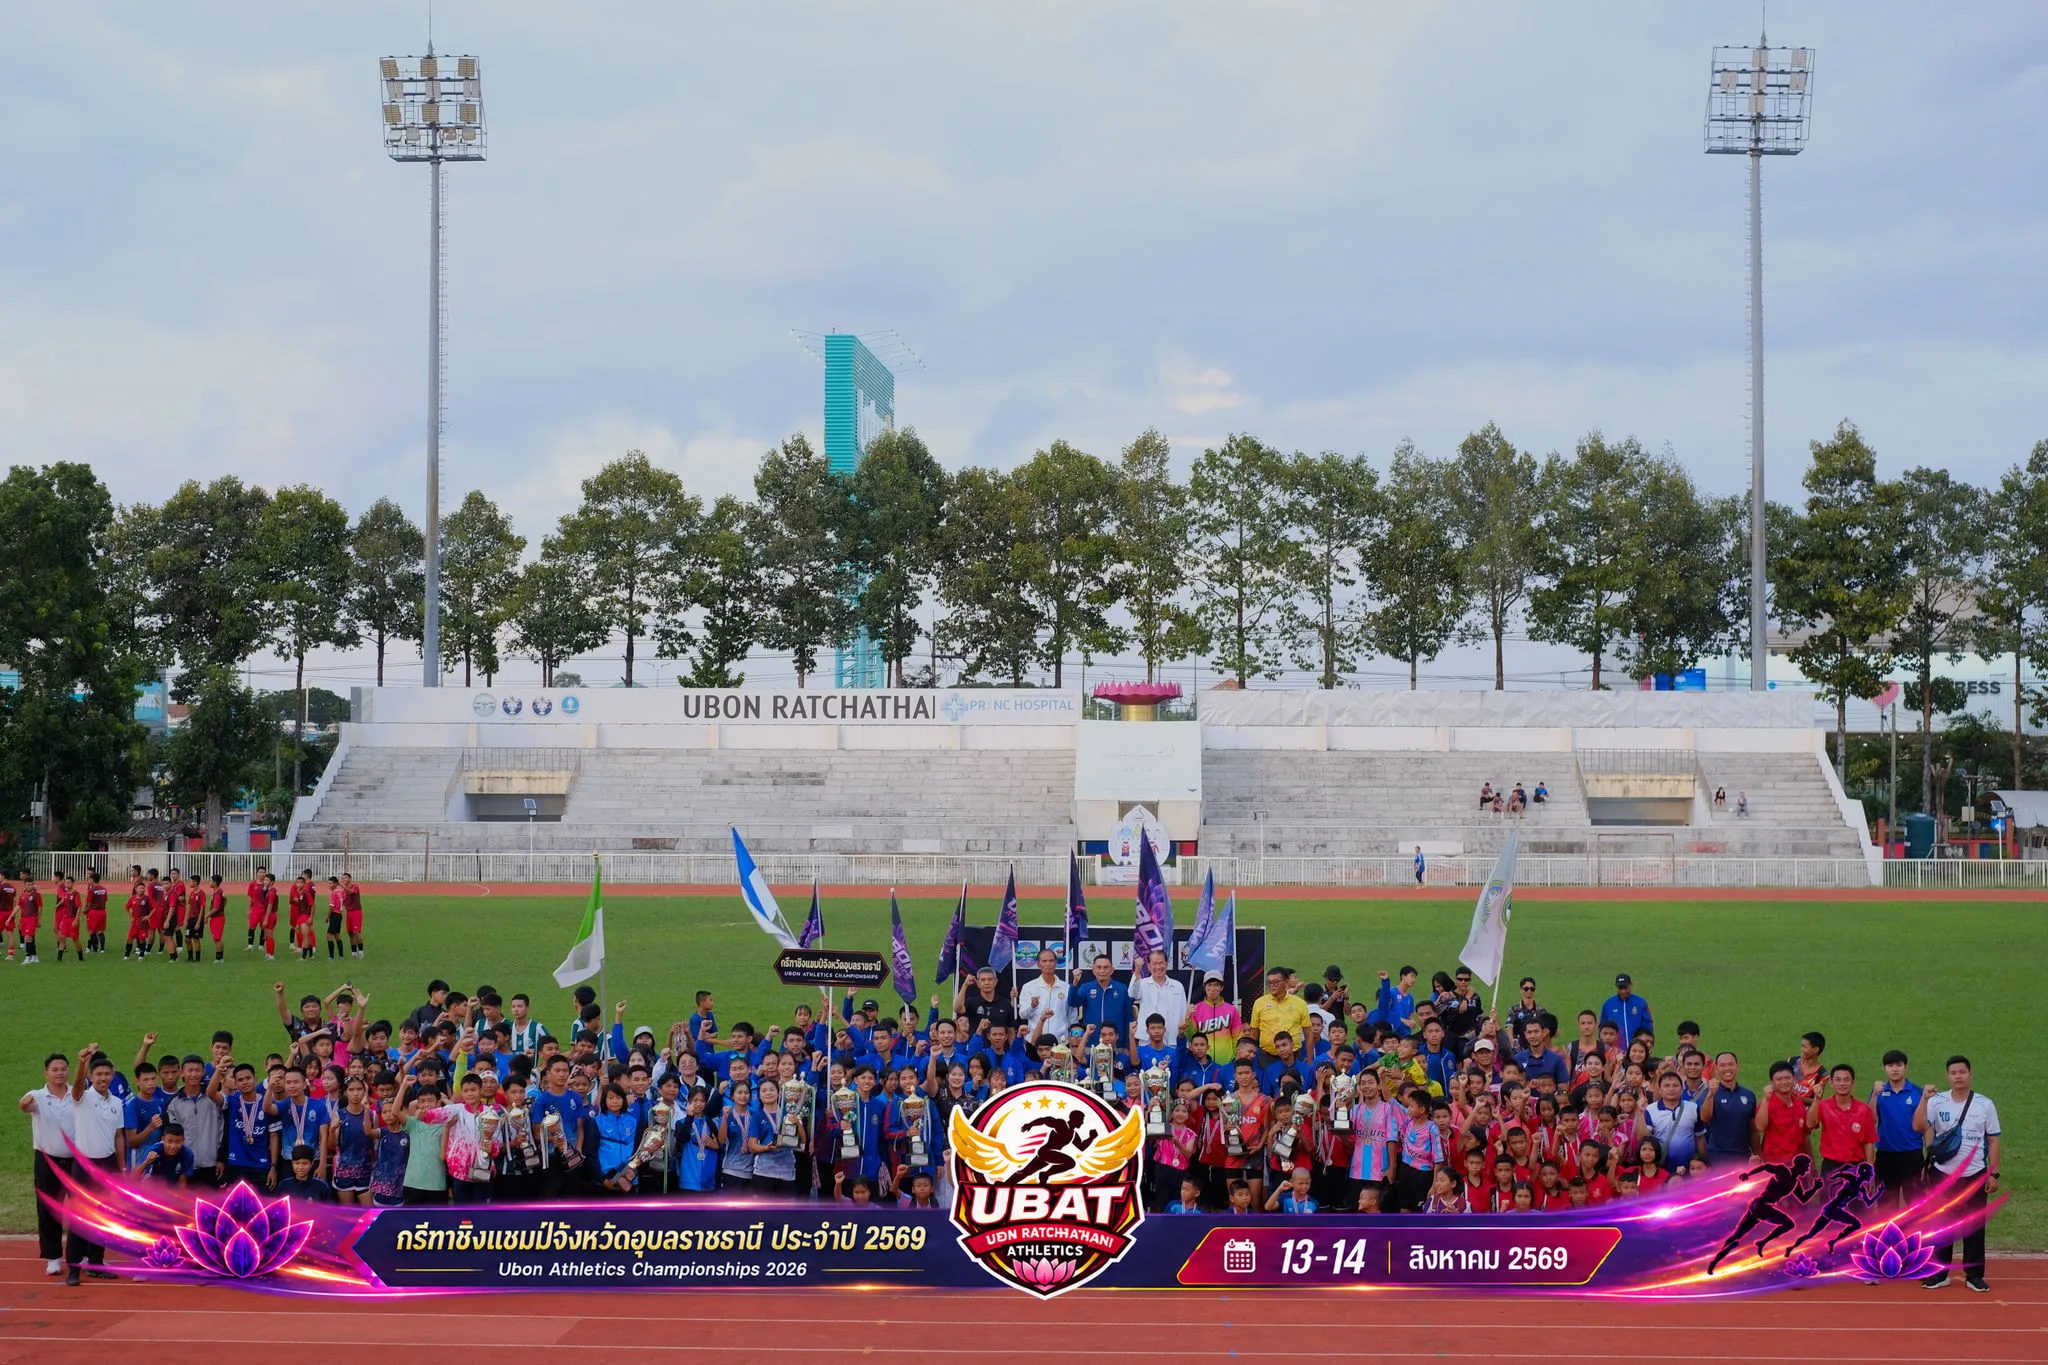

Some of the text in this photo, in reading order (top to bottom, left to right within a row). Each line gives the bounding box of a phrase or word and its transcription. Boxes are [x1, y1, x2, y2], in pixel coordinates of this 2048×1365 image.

[683, 694, 936, 719] UBON RATCHATHA
[1014, 699, 1075, 711] HOSPITAL
[834, 972, 879, 980] CHAMPIONSHIPS
[1197, 1013, 1231, 1034] UBN
